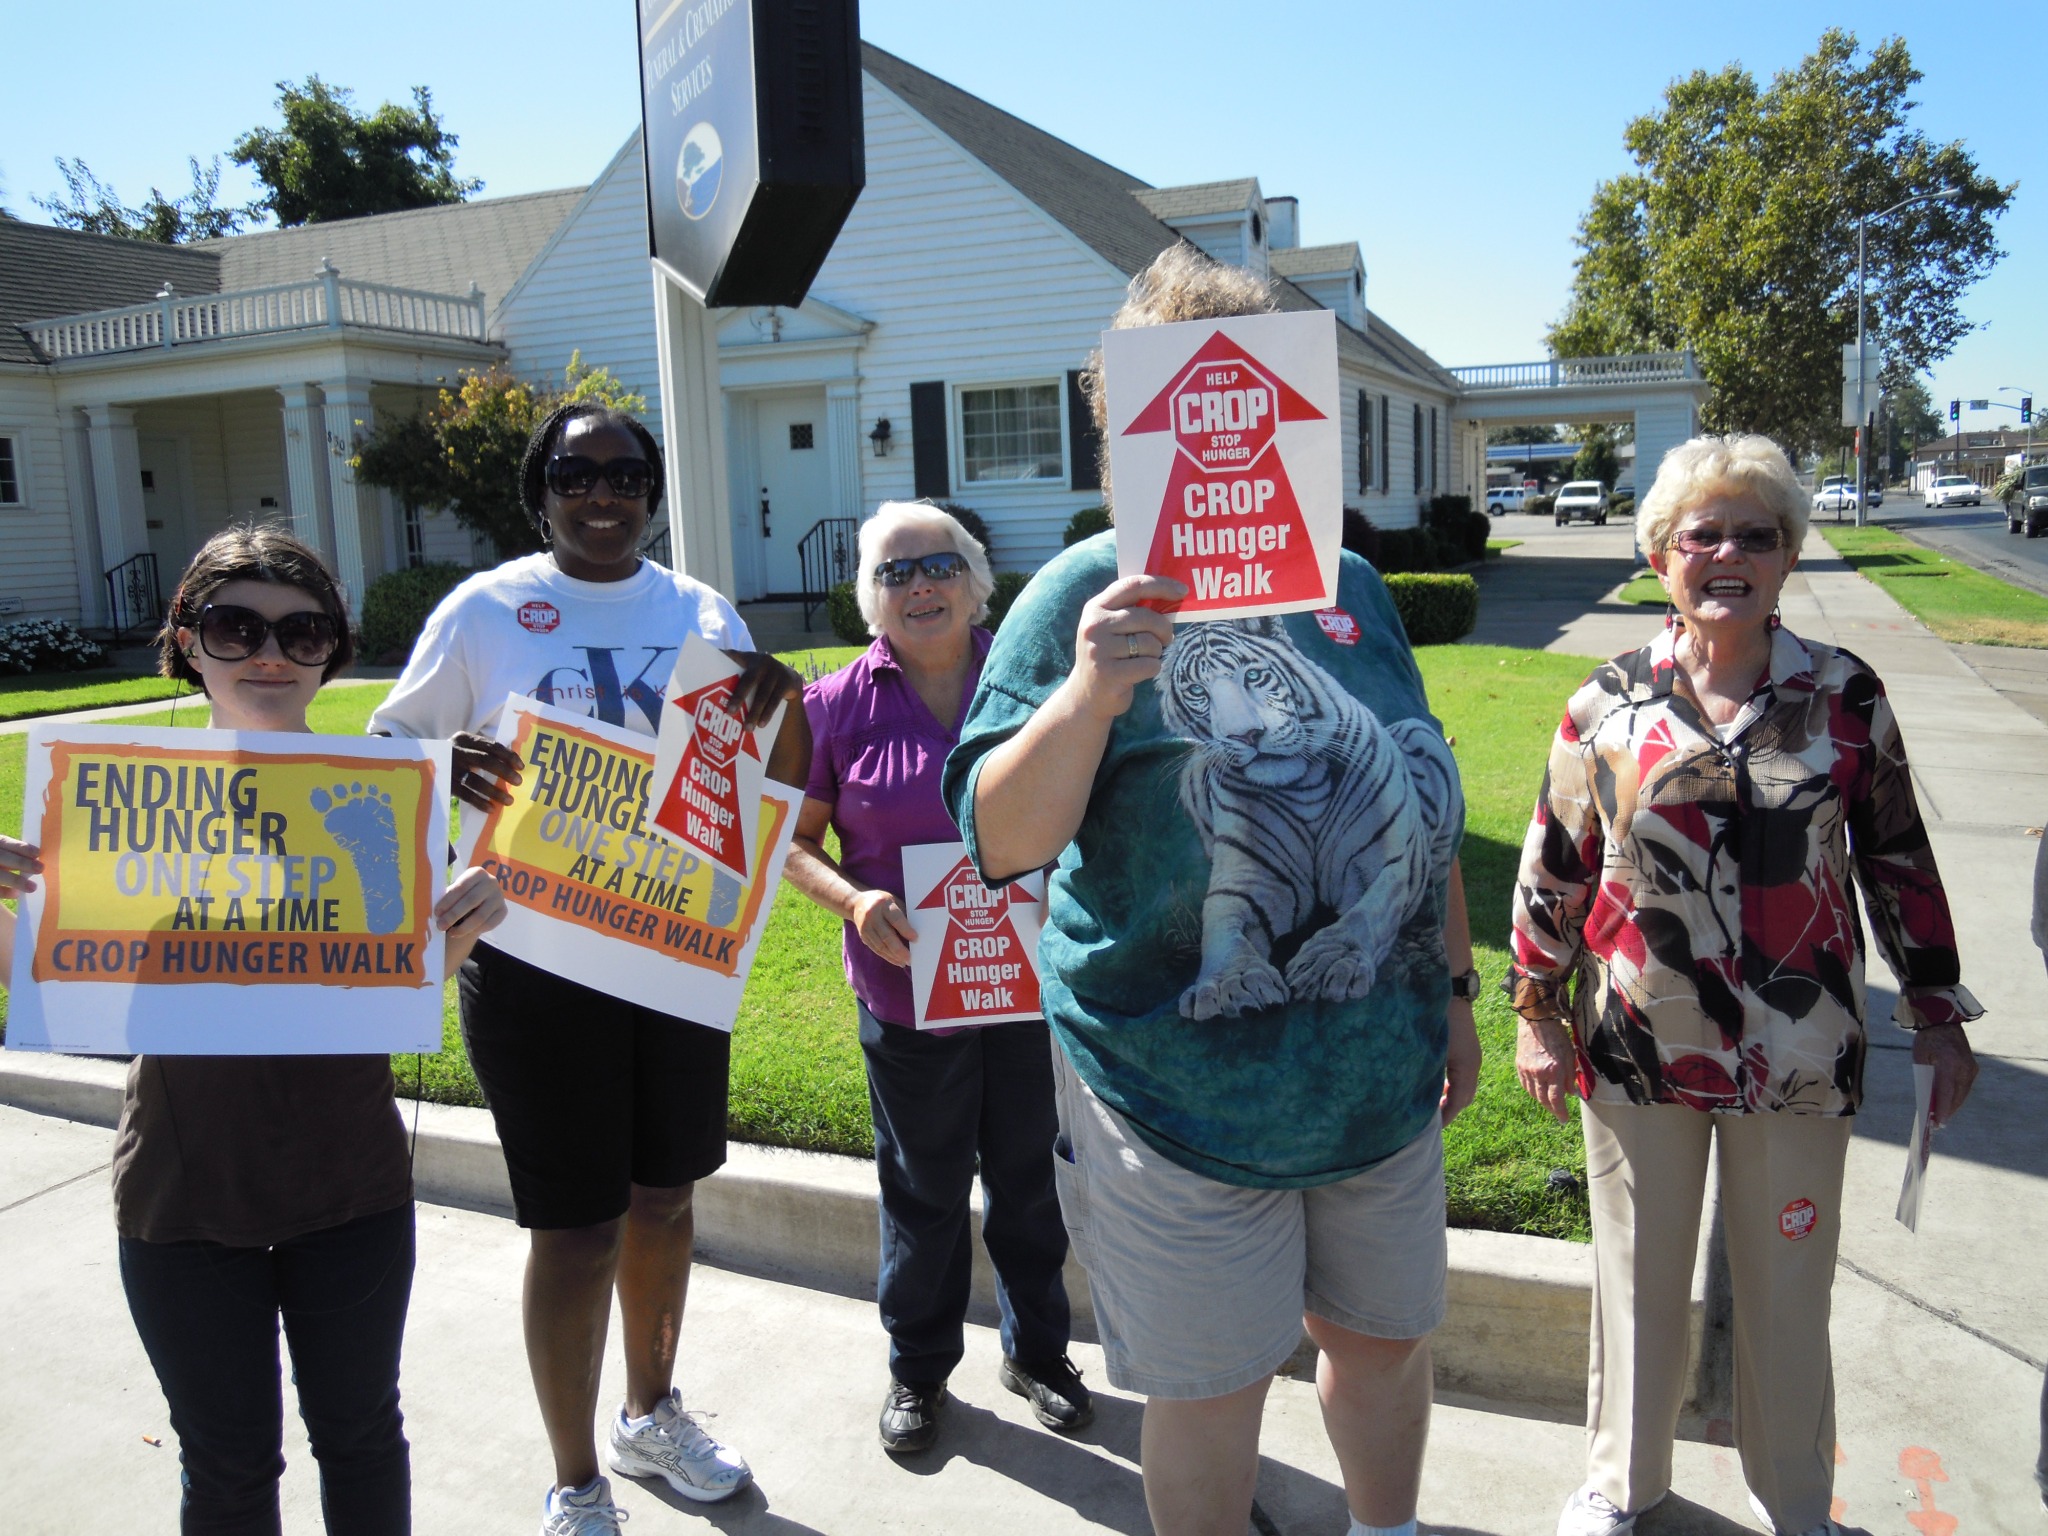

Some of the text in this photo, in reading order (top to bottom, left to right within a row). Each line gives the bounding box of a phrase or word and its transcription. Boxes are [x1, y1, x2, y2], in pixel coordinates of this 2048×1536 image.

[679, 28, 685, 58] &
[671, 54, 712, 117] SERVICES
[1206, 371, 1238, 386] HELP
[1178, 387, 1269, 434] CROP
[1202, 447, 1250, 462] HUNGER
[1211, 434, 1242, 448] STOP
[1183, 479, 1275, 518] CROP
[1171, 522, 1291, 560] Hunger
[1191, 563, 1273, 601] Walk
[520, 609, 557, 624] CROP
[1316, 615, 1354, 633] CROP
[698, 699, 743, 747] CROP
[702, 741, 725, 762] HUNGER
[709, 735, 723, 750] STOP
[76, 763, 258, 812] ENDING
[689, 757, 731, 799] CROP
[530, 767, 670, 846] HUNGE
[680, 777, 734, 829] Hunger
[89, 806, 287, 856] HUNGER
[539, 808, 700, 886] ONE STEP
[686, 811, 724, 855] Walk
[115, 851, 337, 900] ONE STEP
[567, 854, 693, 915] AT A TIME
[172, 896, 339, 932] AT A TIME
[949, 884, 1004, 909] CROP
[970, 910, 988, 918] STOP
[551, 883, 659, 940] HUNGER
[664, 920, 736, 964] WALK
[965, 917, 995, 926] HUNGER
[53, 939, 415, 975] CROP HUNGER WALK
[954, 936, 1011, 960] CROP
[947, 962, 1022, 985] Hunger
[960, 986, 1014, 1011] Walk
[1782, 1206, 1814, 1230] CROP
